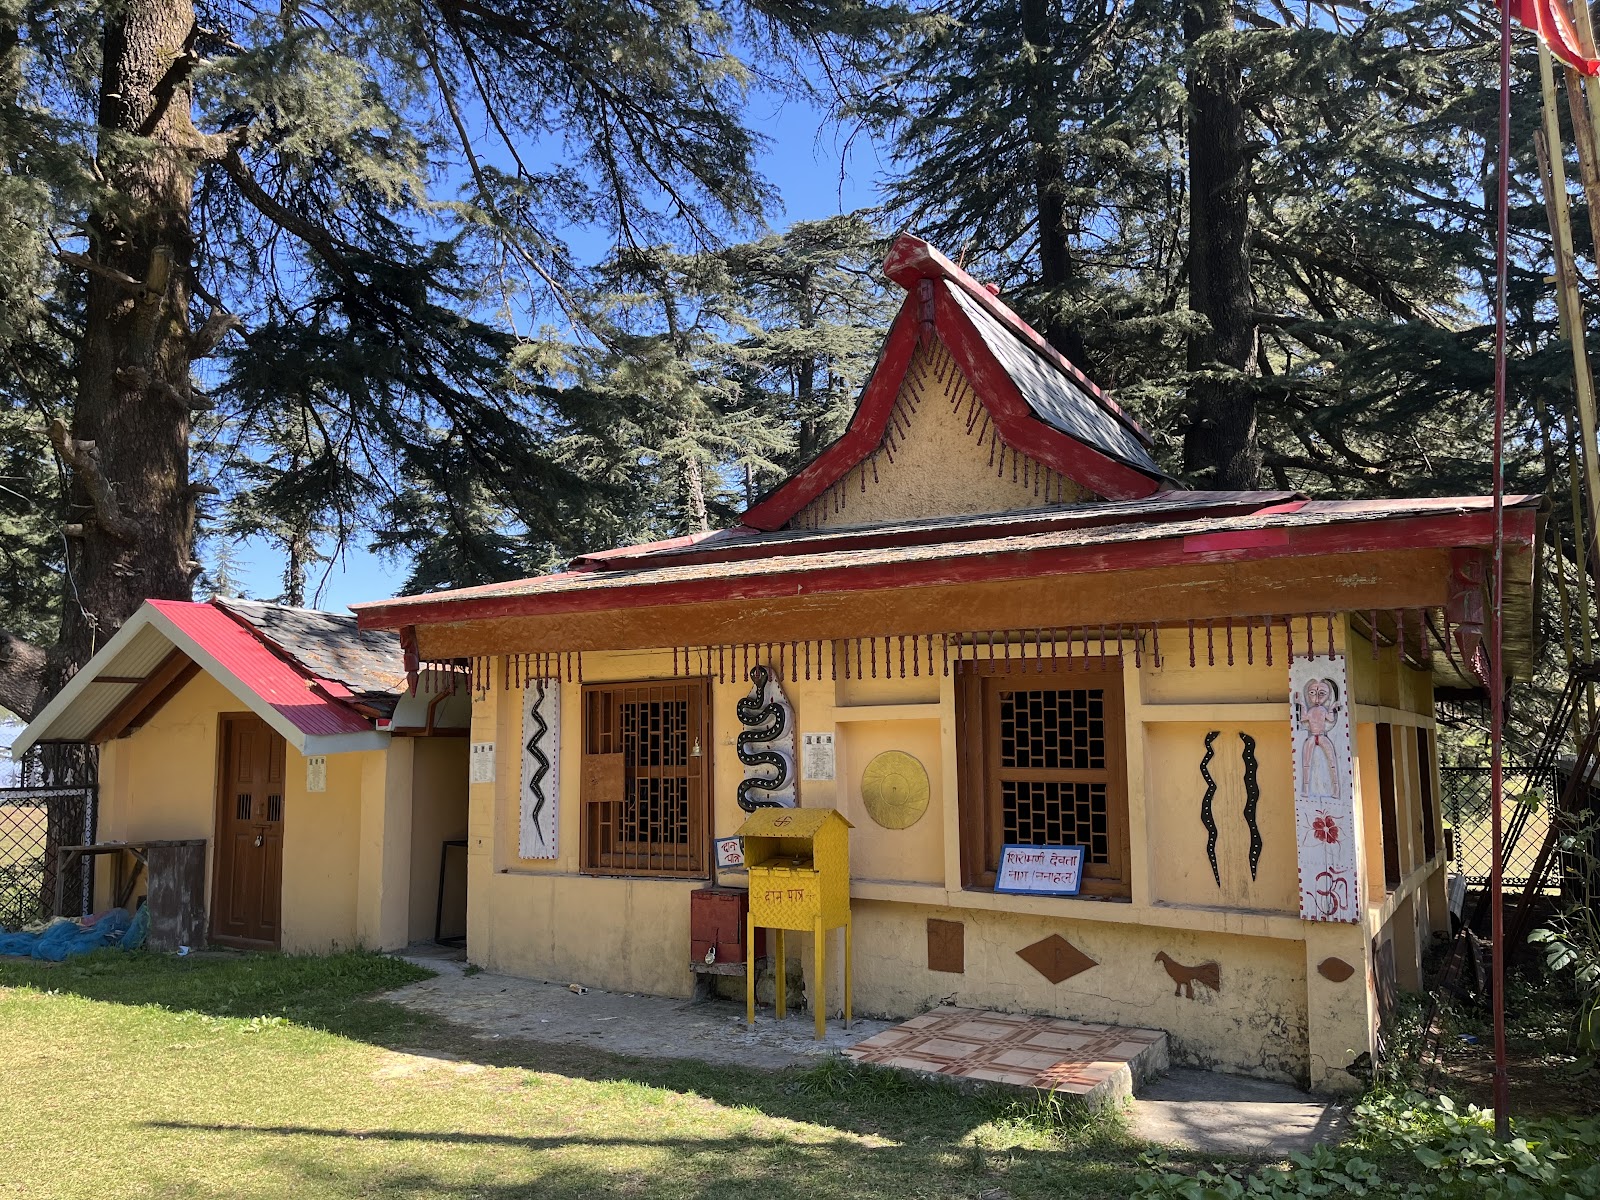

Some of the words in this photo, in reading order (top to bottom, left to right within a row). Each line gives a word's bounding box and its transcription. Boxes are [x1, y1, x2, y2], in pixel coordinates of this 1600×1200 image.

[721, 841, 738, 853] दान
[724, 853, 741, 863] पात्र
[1049, 852, 1077, 866] देवता
[1008, 870, 1028, 882] नाग
[764, 890, 783, 904] दान
[787, 888, 804, 902] पात्र
